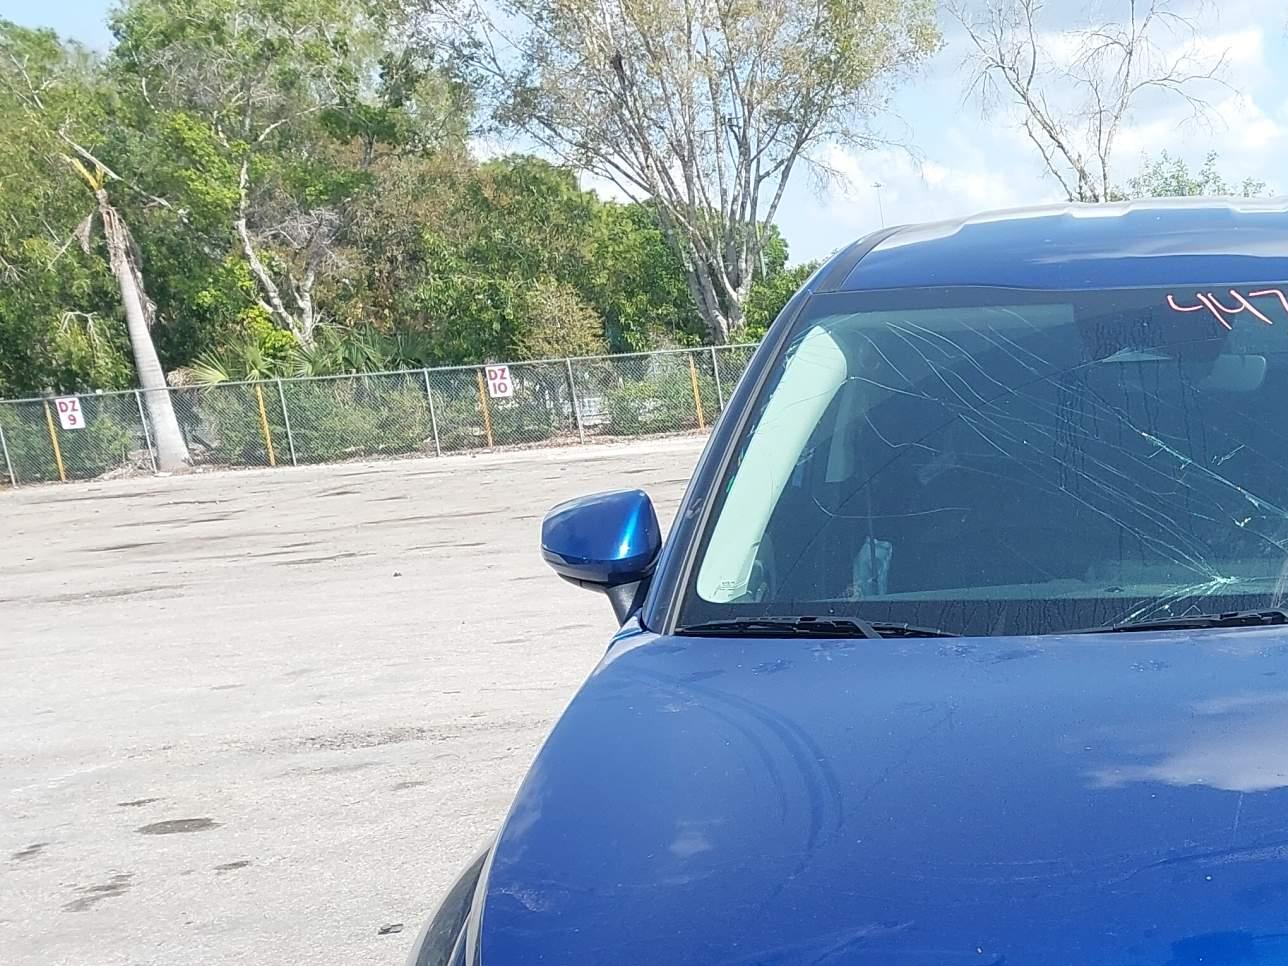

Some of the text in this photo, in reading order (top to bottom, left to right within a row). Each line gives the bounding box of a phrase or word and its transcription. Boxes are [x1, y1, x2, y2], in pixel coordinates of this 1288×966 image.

[487, 368, 508, 381] DZ
[492, 382, 508, 395] 10
[58, 400, 79, 413] DZ
[67, 413, 77, 426] 9
